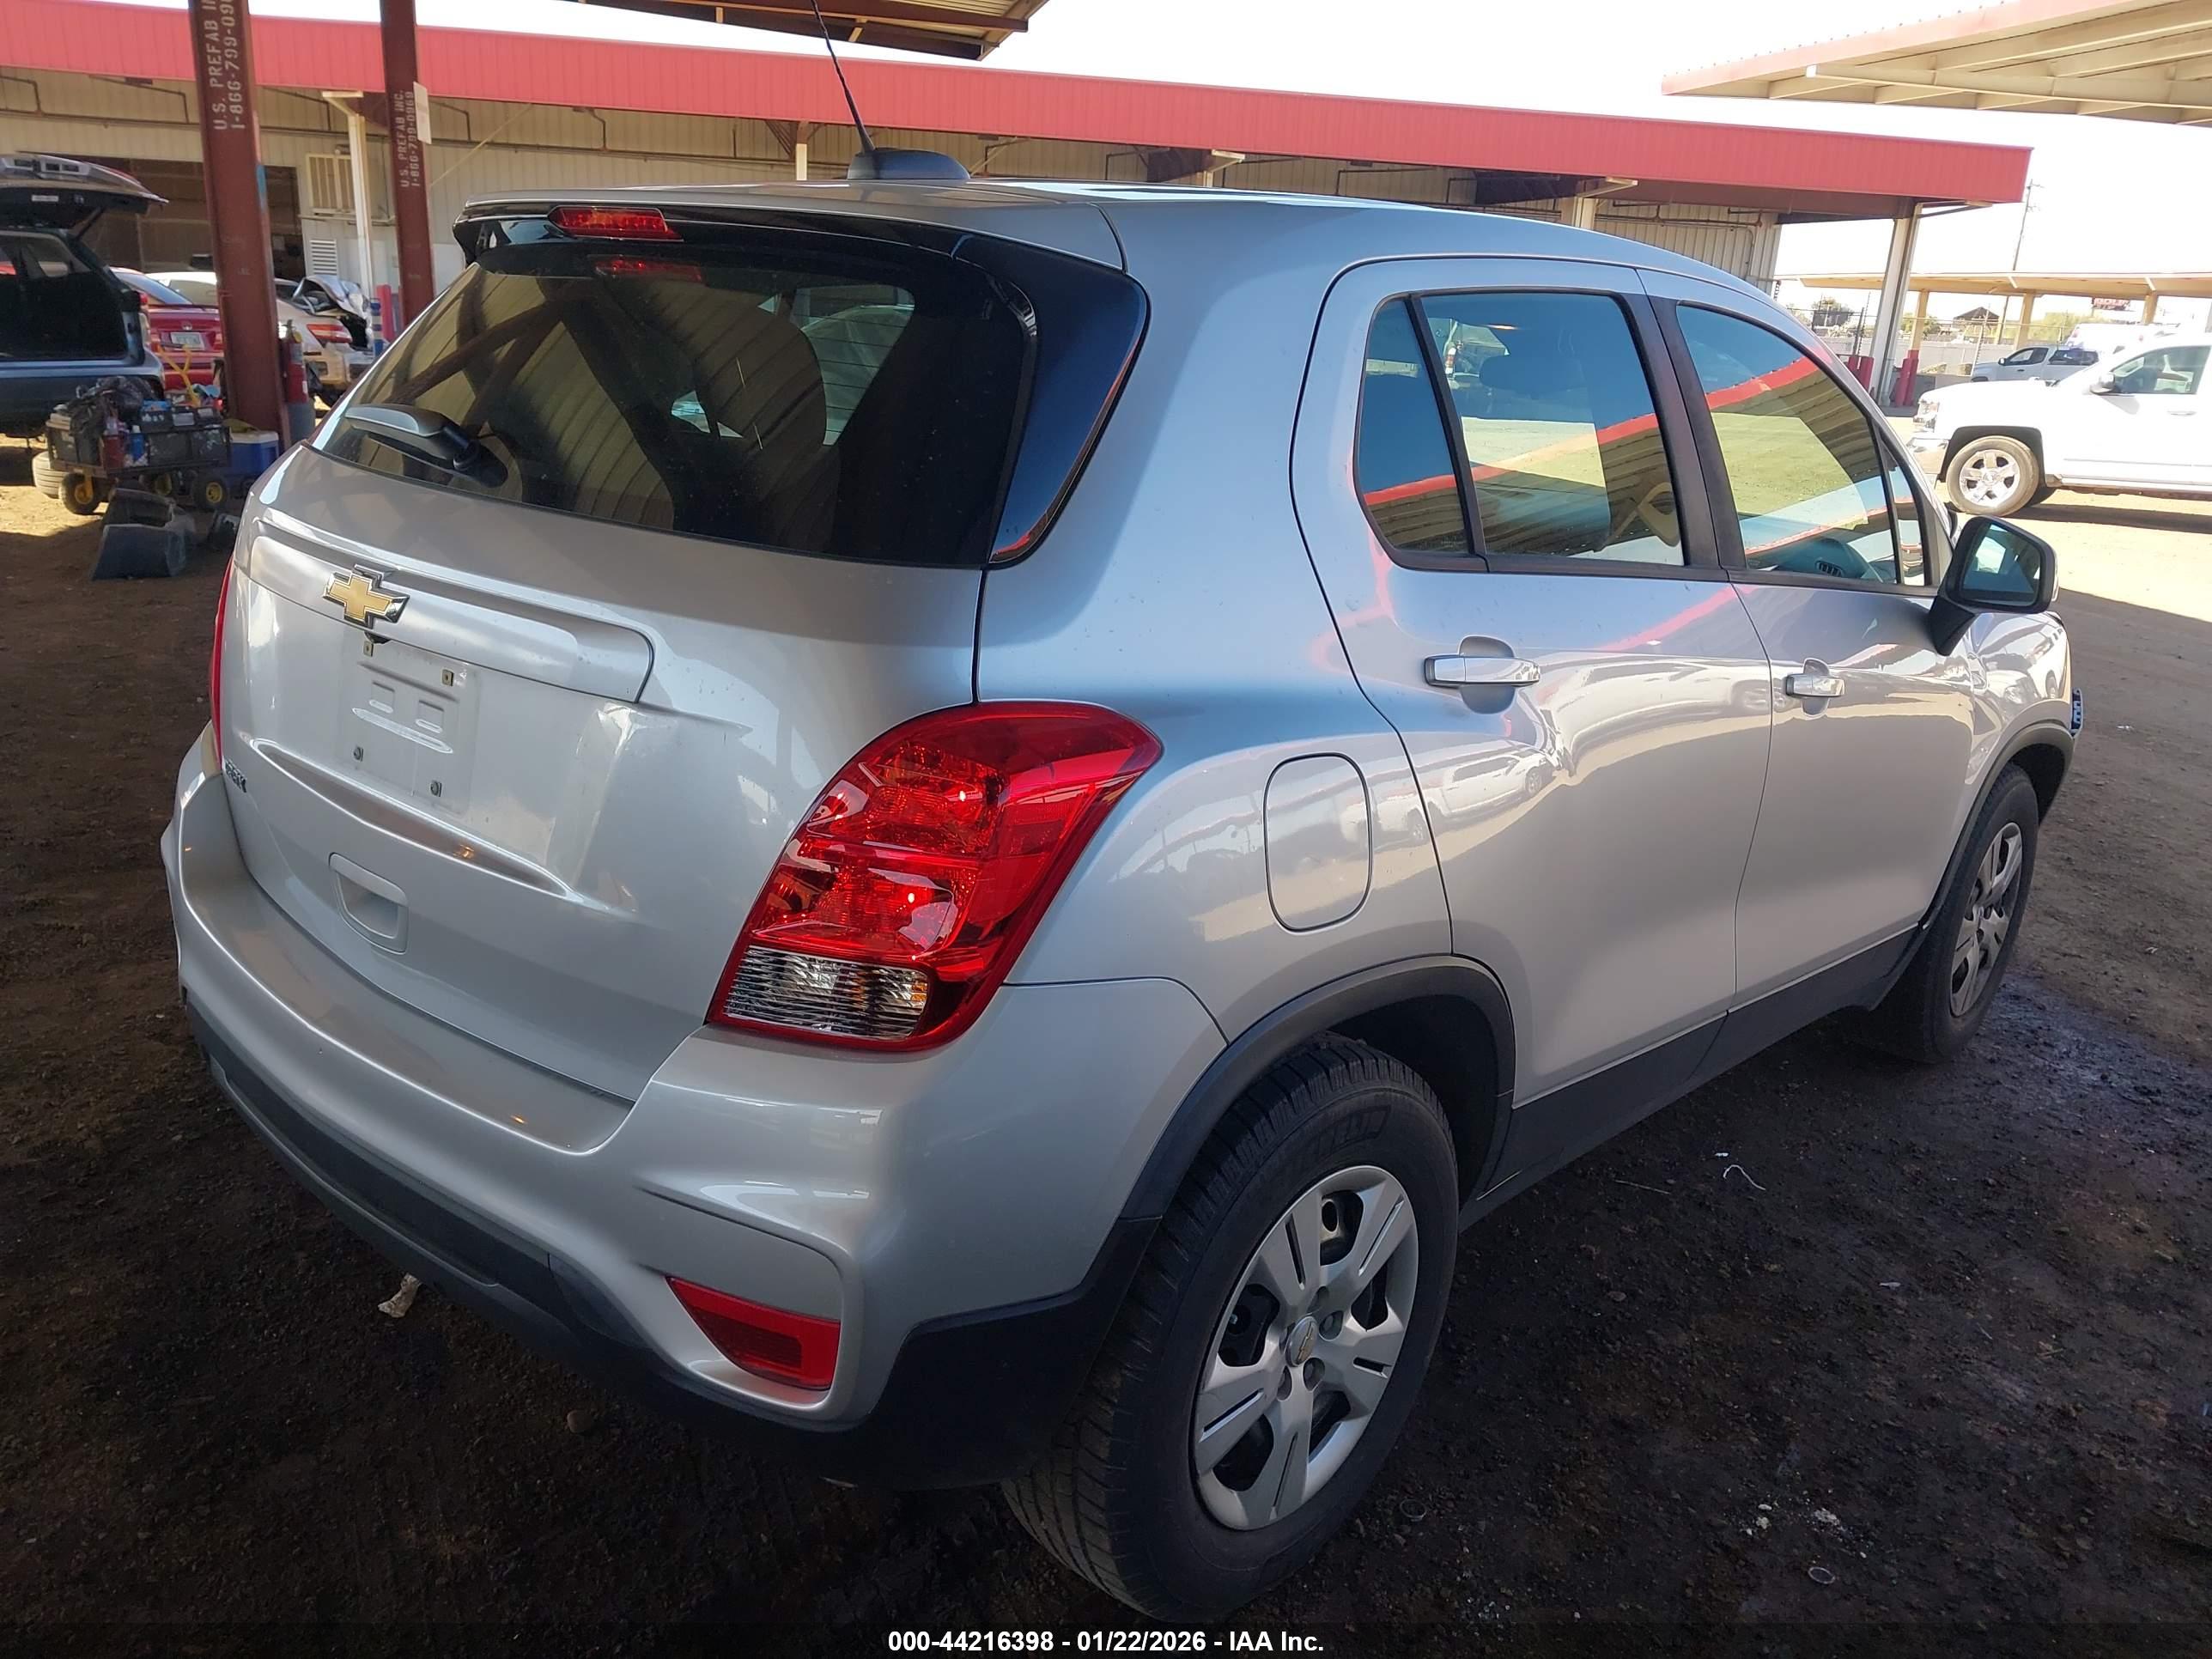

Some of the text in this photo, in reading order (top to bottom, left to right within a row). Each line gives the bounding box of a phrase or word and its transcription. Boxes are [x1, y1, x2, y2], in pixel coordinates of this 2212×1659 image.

[204, 20, 224, 88] PREFAB
[219, 0, 246, 129] 1-866-799-09
[211, 97, 228, 130] U.S.
[396, 117, 407, 161] PREFAB
[398, 165, 410, 187] U.S.
